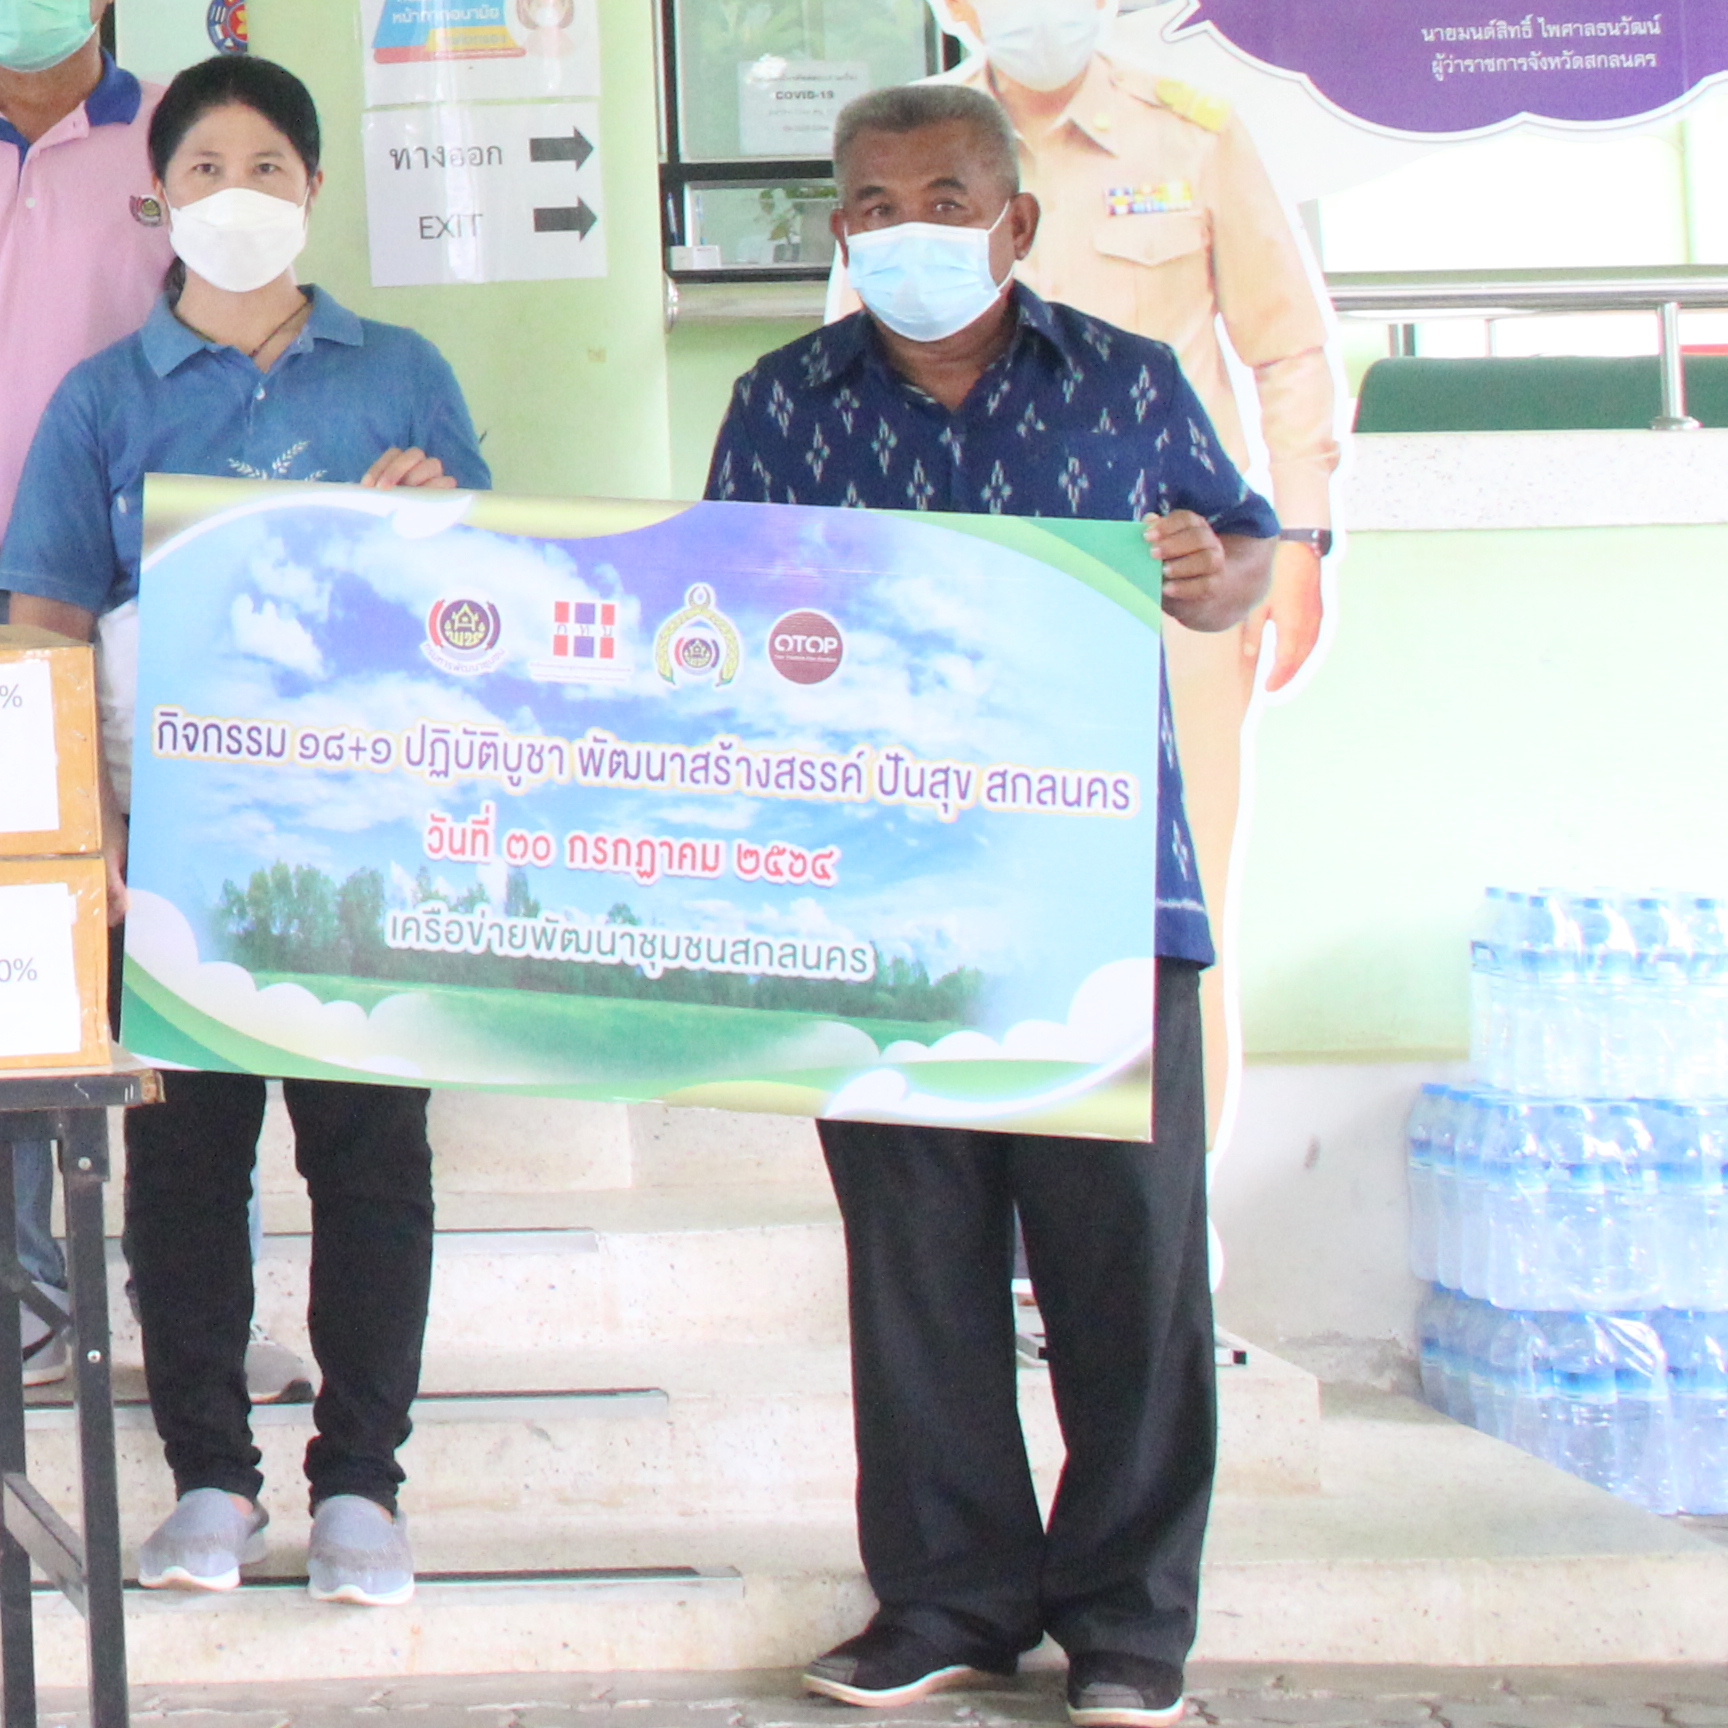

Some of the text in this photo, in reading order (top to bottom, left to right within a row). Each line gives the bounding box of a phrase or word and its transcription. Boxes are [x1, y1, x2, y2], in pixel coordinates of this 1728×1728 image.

[390, 140, 503, 170] ทางออก
[419, 213, 484, 239] EXIT
[774, 634, 838, 654] OTOP
[157, 711, 286, 759] กิจกรรม
[298, 729, 392, 764] ๑๘+๑
[406, 724, 564, 787] ปฏิบัติบูชา
[577, 735, 866, 795] พัฒนาสร้างสรรค์
[987, 770, 1131, 811] สกลนคร
[427, 805, 491, 858] วันที่
[506, 832, 551, 862] ๓๐
[736, 843, 836, 881] ๒๕๖๔
[391, 907, 868, 974] เครือข่ายพัฒนาชุมชนสกลนคร
